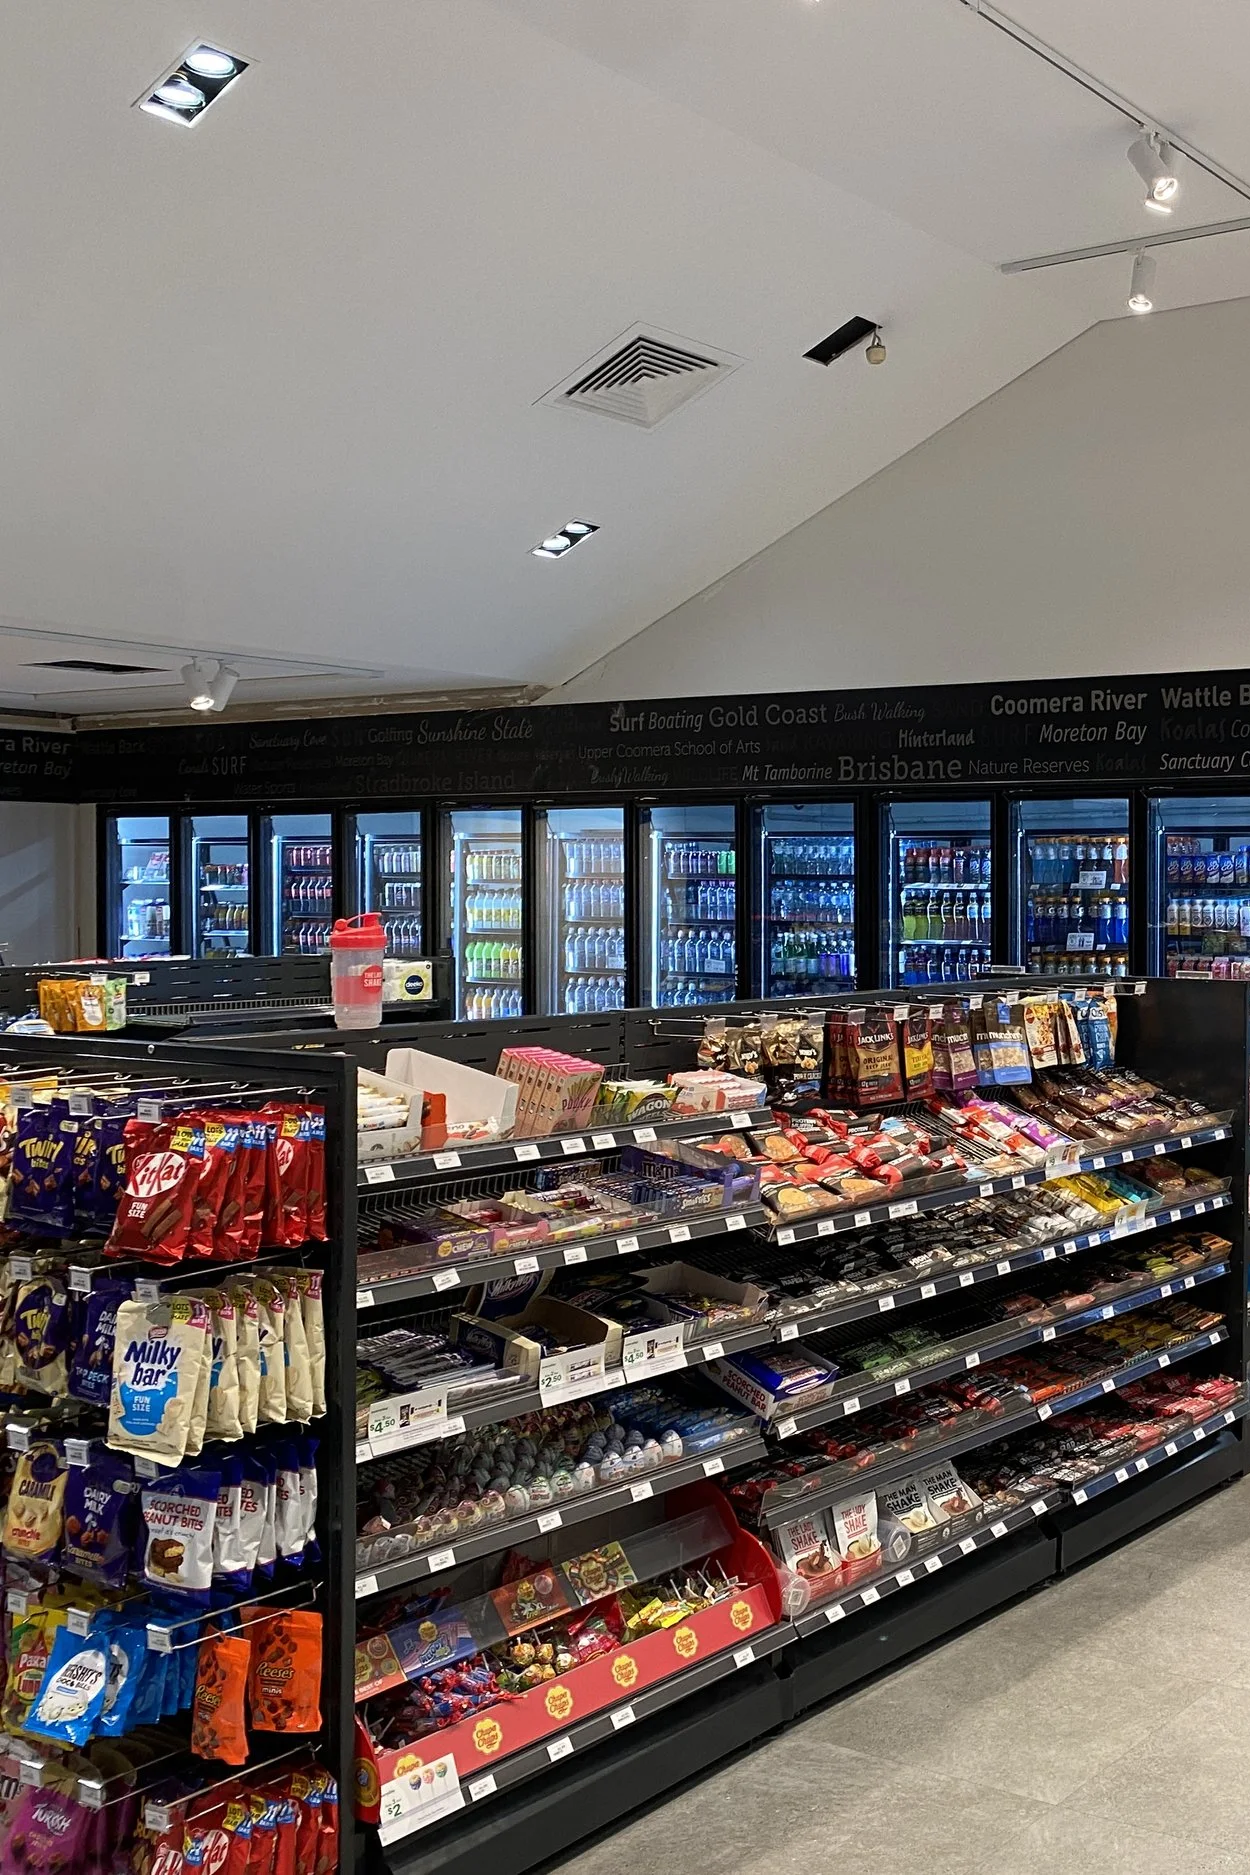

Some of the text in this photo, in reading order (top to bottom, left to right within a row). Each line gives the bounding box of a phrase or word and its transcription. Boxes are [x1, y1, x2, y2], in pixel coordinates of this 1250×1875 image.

[990, 688, 1148, 716] Coomera River
[1160, 684, 1232, 711] Wattle
[648, 710, 704, 733] Boating
[708, 703, 828, 730] Gold Coast
[834, 701, 926, 723] Bush Walking
[417, 718, 487, 745] Sunshine
[491, 714, 533, 742] State
[609, 712, 645, 732] Surf
[367, 727, 413, 746] Golfing
[897, 728, 976, 749] Hinterland
[1039, 720, 1148, 745] Moreton Bay
[22, 736, 71, 756] River
[578, 744, 613, 762] Upper
[615, 742, 672, 759] Coomera
[674, 739, 717, 757] School
[719, 739, 733, 755] of
[735, 738, 761, 754] Arts
[212, 755, 248, 777] SURF
[741, 762, 833, 781] Mt Tamborine
[837, 753, 963, 783] Brisbane
[968, 757, 1090, 776] Nature Reserves
[1159, 752, 1235, 773] Sanctuary
[355, 772, 453, 796] Stradbroke
[457, 770, 516, 791] Island
[627, 1100, 672, 1121] WAGON
[128, 1208, 145, 1219] SIZE
[131, 1201, 149, 1211] FUN
[172, 1303, 189, 1312] LOTS
[124, 1340, 182, 1370] Milky
[624, 1351, 644, 1365] $4.50
[131, 1362, 167, 1386] bar
[541, 1374, 562, 1388] $2.50
[723, 1375, 767, 1413] PEANUT BAR
[728, 1369, 766, 1402] SCORCHED
[132, 1403, 150, 1412] SIZE
[133, 1394, 151, 1404] FUN
[369, 1418, 396, 1433] $4.50
[923, 1469, 952, 1486] THE MAN
[927, 1477, 957, 1496] SHAKE
[83, 1486, 112, 1505] DAIRY
[883, 1484, 917, 1504] THE MAN
[886, 1492, 921, 1512] SHAKE
[83, 1498, 105, 1516] MILK
[150, 1499, 201, 1518] SCORCHED
[841, 1508, 852, 1520] THE
[181, 1516, 204, 1532] BITES
[787, 1521, 814, 1538] THE LADY
[844, 1513, 867, 1534] SHAKE
[791, 1531, 819, 1551] SHAKE
[676, 1633, 693, 1645] Chupa
[678, 1640, 695, 1654] Chups
[255, 1661, 296, 1680] Reese's
[614, 1660, 633, 1673] Chupa
[616, 1668, 635, 1682] Chups
[548, 1692, 568, 1707] Chupa
[550, 1700, 570, 1717] Chups
[476, 1724, 497, 1739] Chupa
[478, 1732, 499, 1749] Chups
[397, 1760, 419, 1776] Chupa
[387, 1802, 402, 1818] $2
